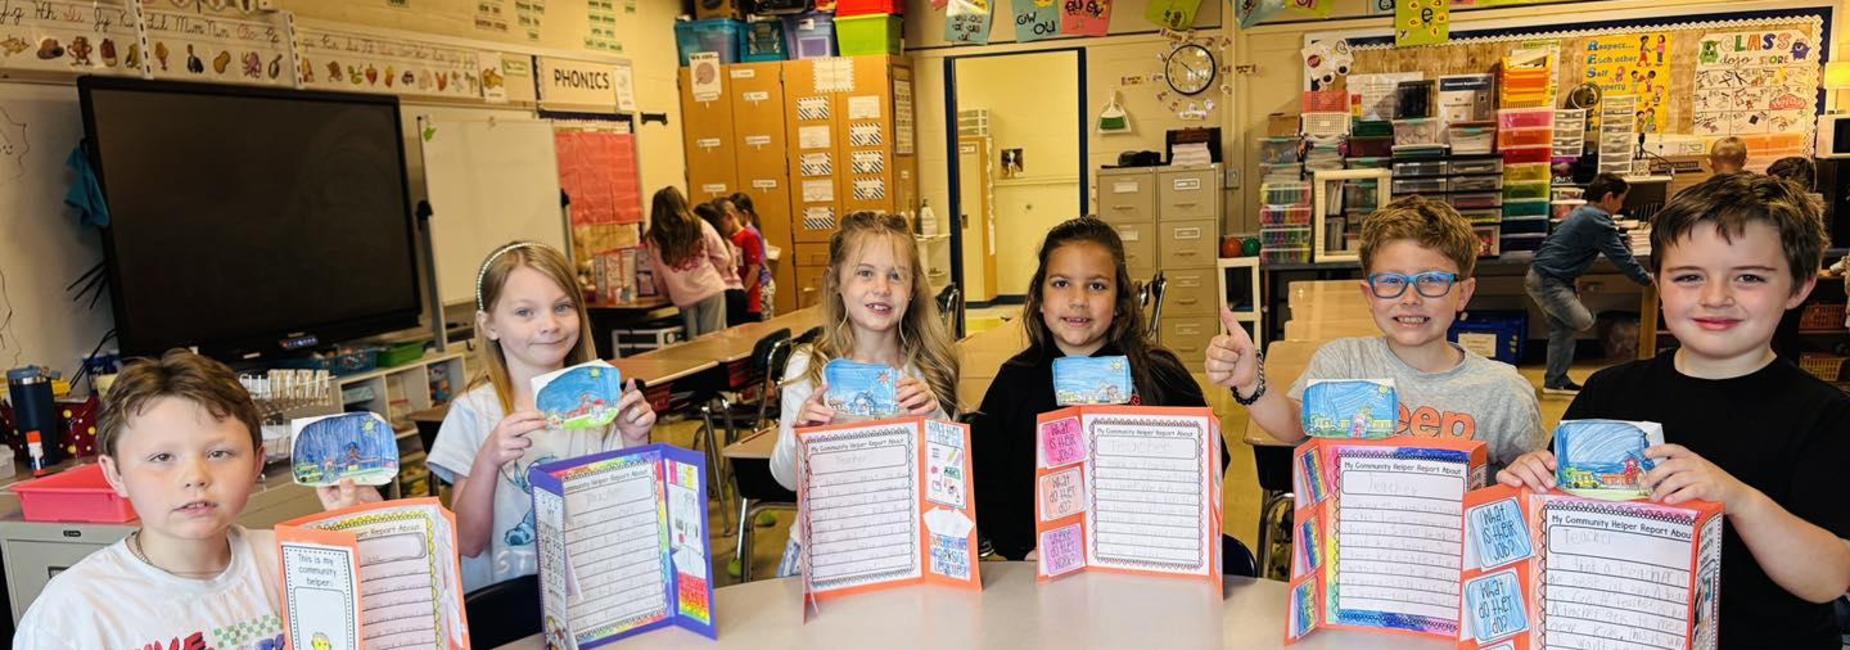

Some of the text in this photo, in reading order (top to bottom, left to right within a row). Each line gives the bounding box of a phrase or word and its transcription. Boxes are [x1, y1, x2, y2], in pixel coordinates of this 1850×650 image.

[1720, 33, 1792, 53] CLASS
[554, 69, 609, 90] PHONICS
[1344, 461, 1462, 475] My Community Helper Report About
[1551, 515, 1692, 539] My Community Helper Report Abou
